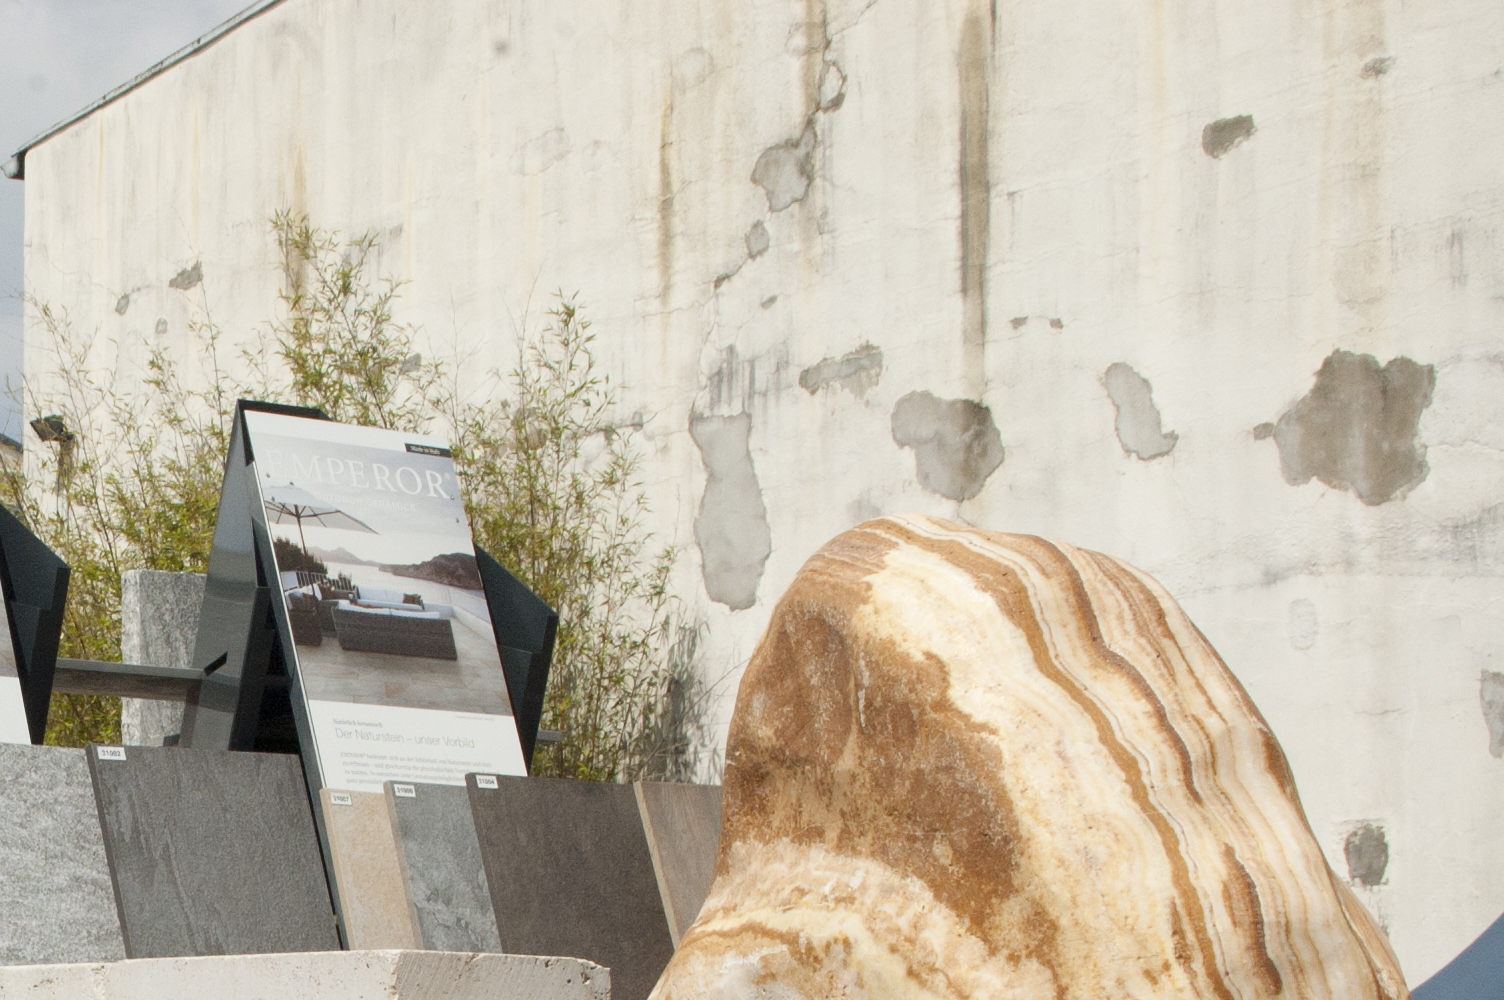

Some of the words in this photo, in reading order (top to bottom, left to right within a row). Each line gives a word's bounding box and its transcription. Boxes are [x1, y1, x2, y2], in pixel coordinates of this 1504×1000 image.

[316, 492, 363, 506] OUTDOOR
[366, 499, 416, 512] CERAMICS
[335, 728, 352, 739] Der
[355, 730, 404, 743] Naturstein
[415, 736, 440, 746] unser
[442, 736, 475, 748] Vorbild
